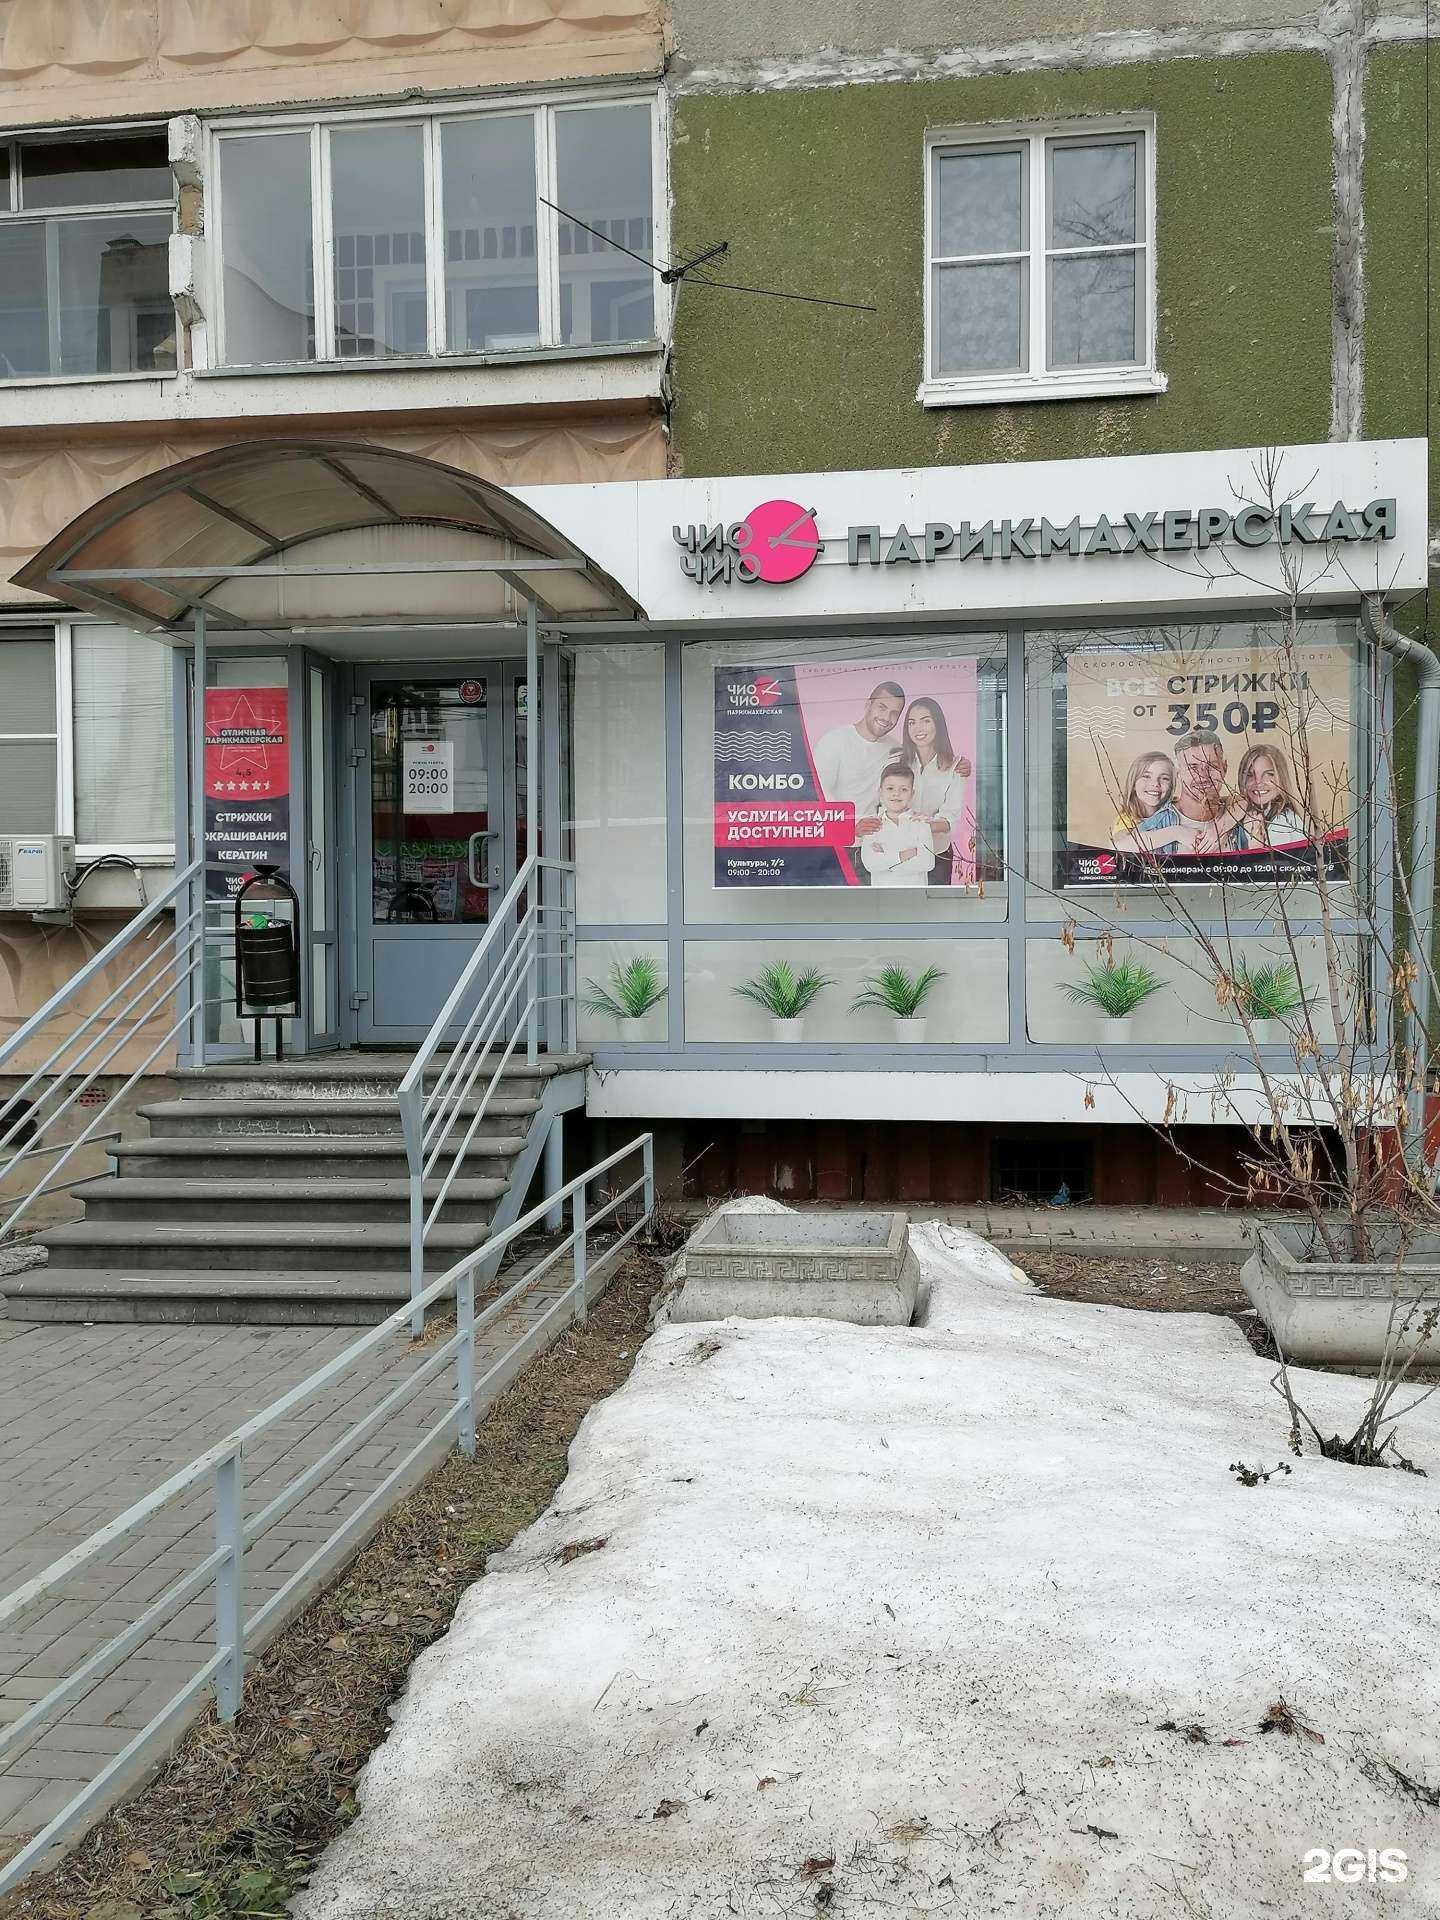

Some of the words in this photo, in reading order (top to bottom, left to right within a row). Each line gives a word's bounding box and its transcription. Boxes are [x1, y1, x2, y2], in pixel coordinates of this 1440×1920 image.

[673, 522, 752, 553] ЧИО
[848, 498, 1396, 567] ПАРИКМАХЕРСКАЯ
[680, 553, 761, 584] ЧИО
[1166, 672, 1308, 695] СТРИЖКИ
[727, 684, 757, 695] ЧИО
[730, 695, 760, 706] ЧИО
[1165, 701, 1280, 736] 350₽
[221, 729, 266, 737] ОТЛИЧНАЯ
[205, 736, 283, 745] ПАРИКМАХЕРСКАЯ
[408, 768, 448, 780] 09:00
[729, 773, 804, 790] КОМБО
[408, 782, 448, 794] 20:00
[215, 812, 272, 822] СТРИЖКИ
[727, 810, 789, 823] УСЛУГИ
[793, 809, 845, 822] СТАЛИ
[727, 822, 825, 841] ДОСТУПНЕЙ
[218, 850, 268, 860] КЕРАТИН
[727, 859, 769, 869] Культуры,
[770, 858, 785, 868] 7/2
[1078, 859, 1100, 868] ЧИО
[757, 868, 781, 876] 20:00
[1080, 867, 1101, 875] ЧИО
[228, 884, 243, 893] ЧИ
